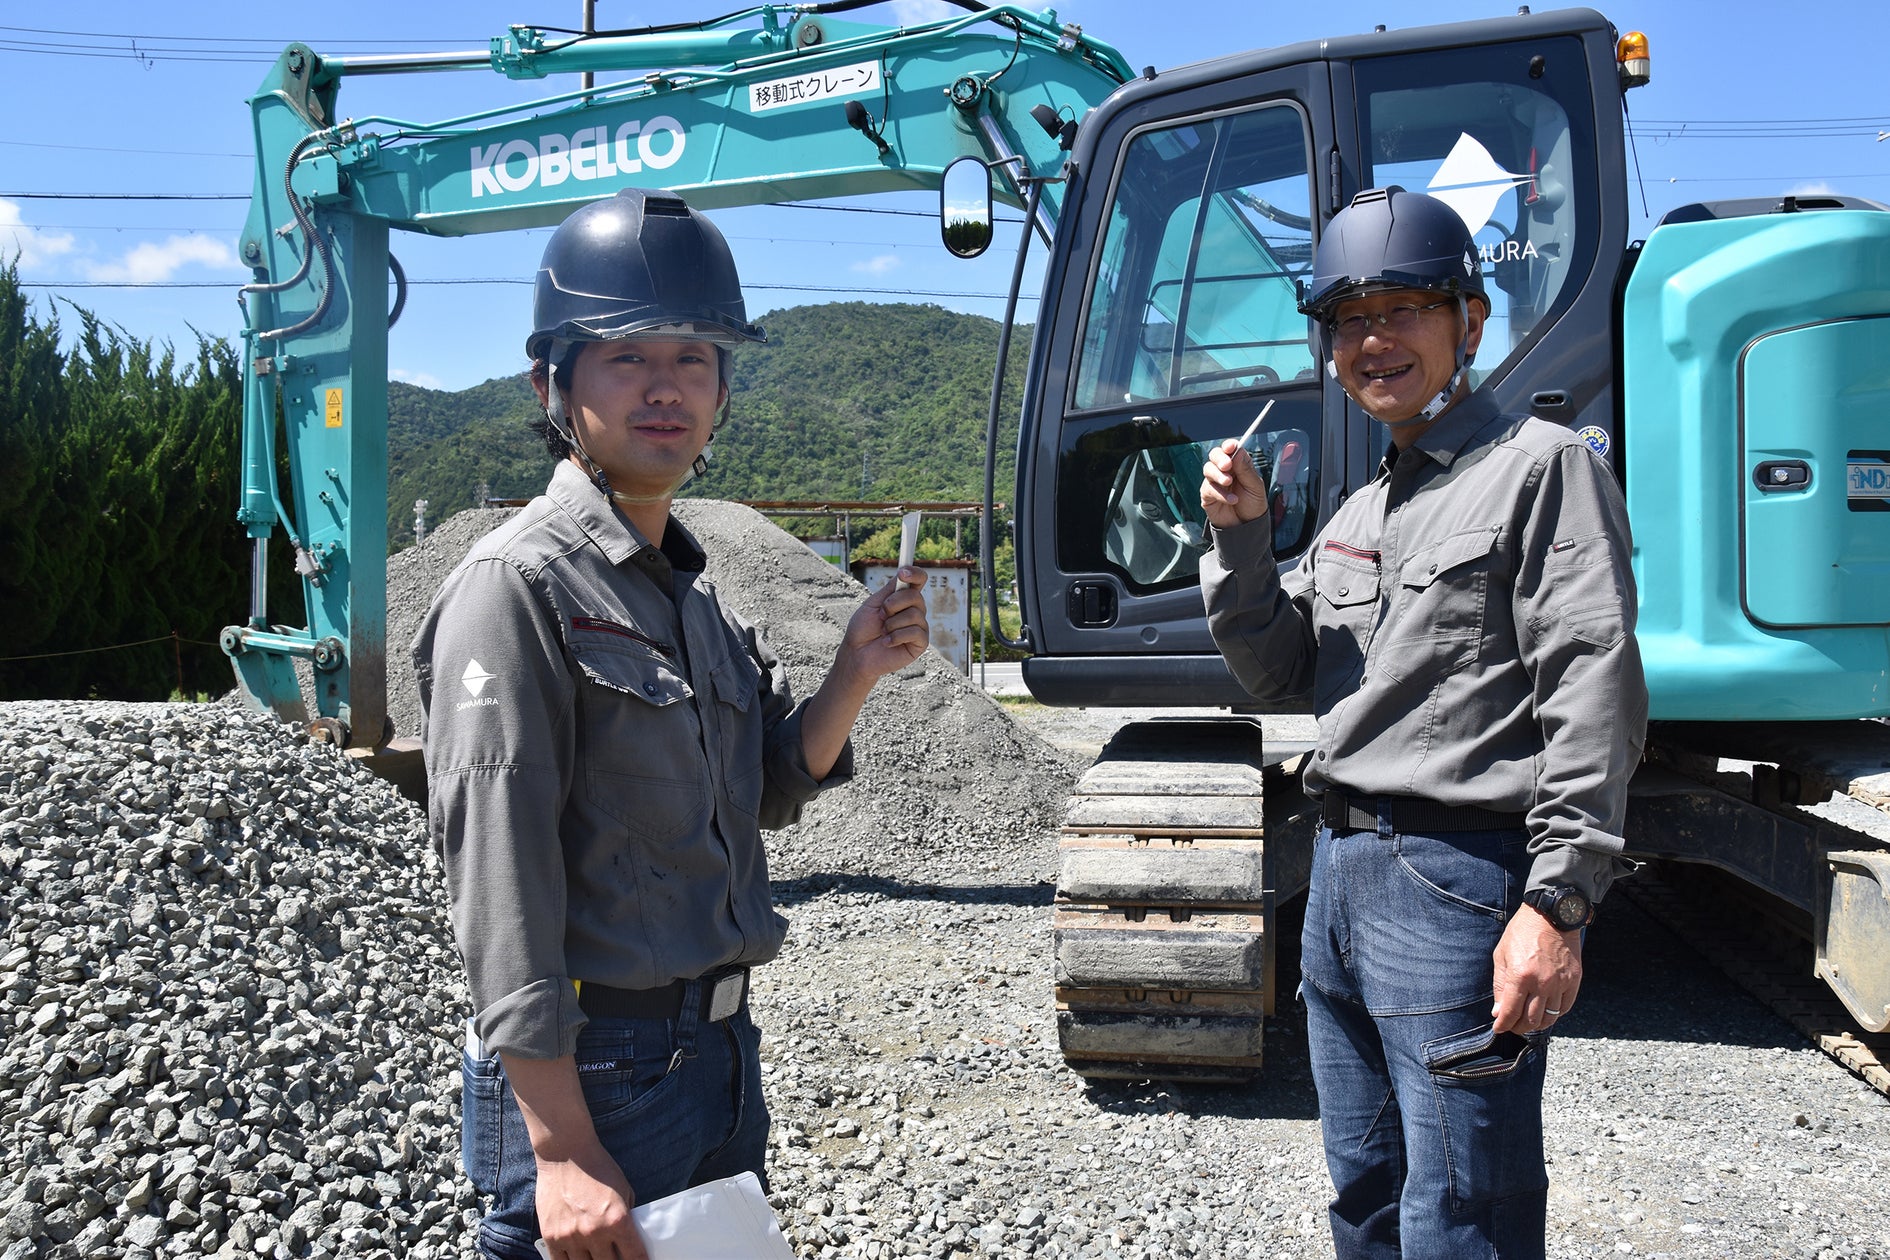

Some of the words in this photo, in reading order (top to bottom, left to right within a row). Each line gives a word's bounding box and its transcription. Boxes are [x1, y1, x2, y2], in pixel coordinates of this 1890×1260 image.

[755, 70, 873, 107] 移動式クレーン
[470, 115, 686, 198] KOBELCO
[456, 697, 500, 711] SAWAMURA
